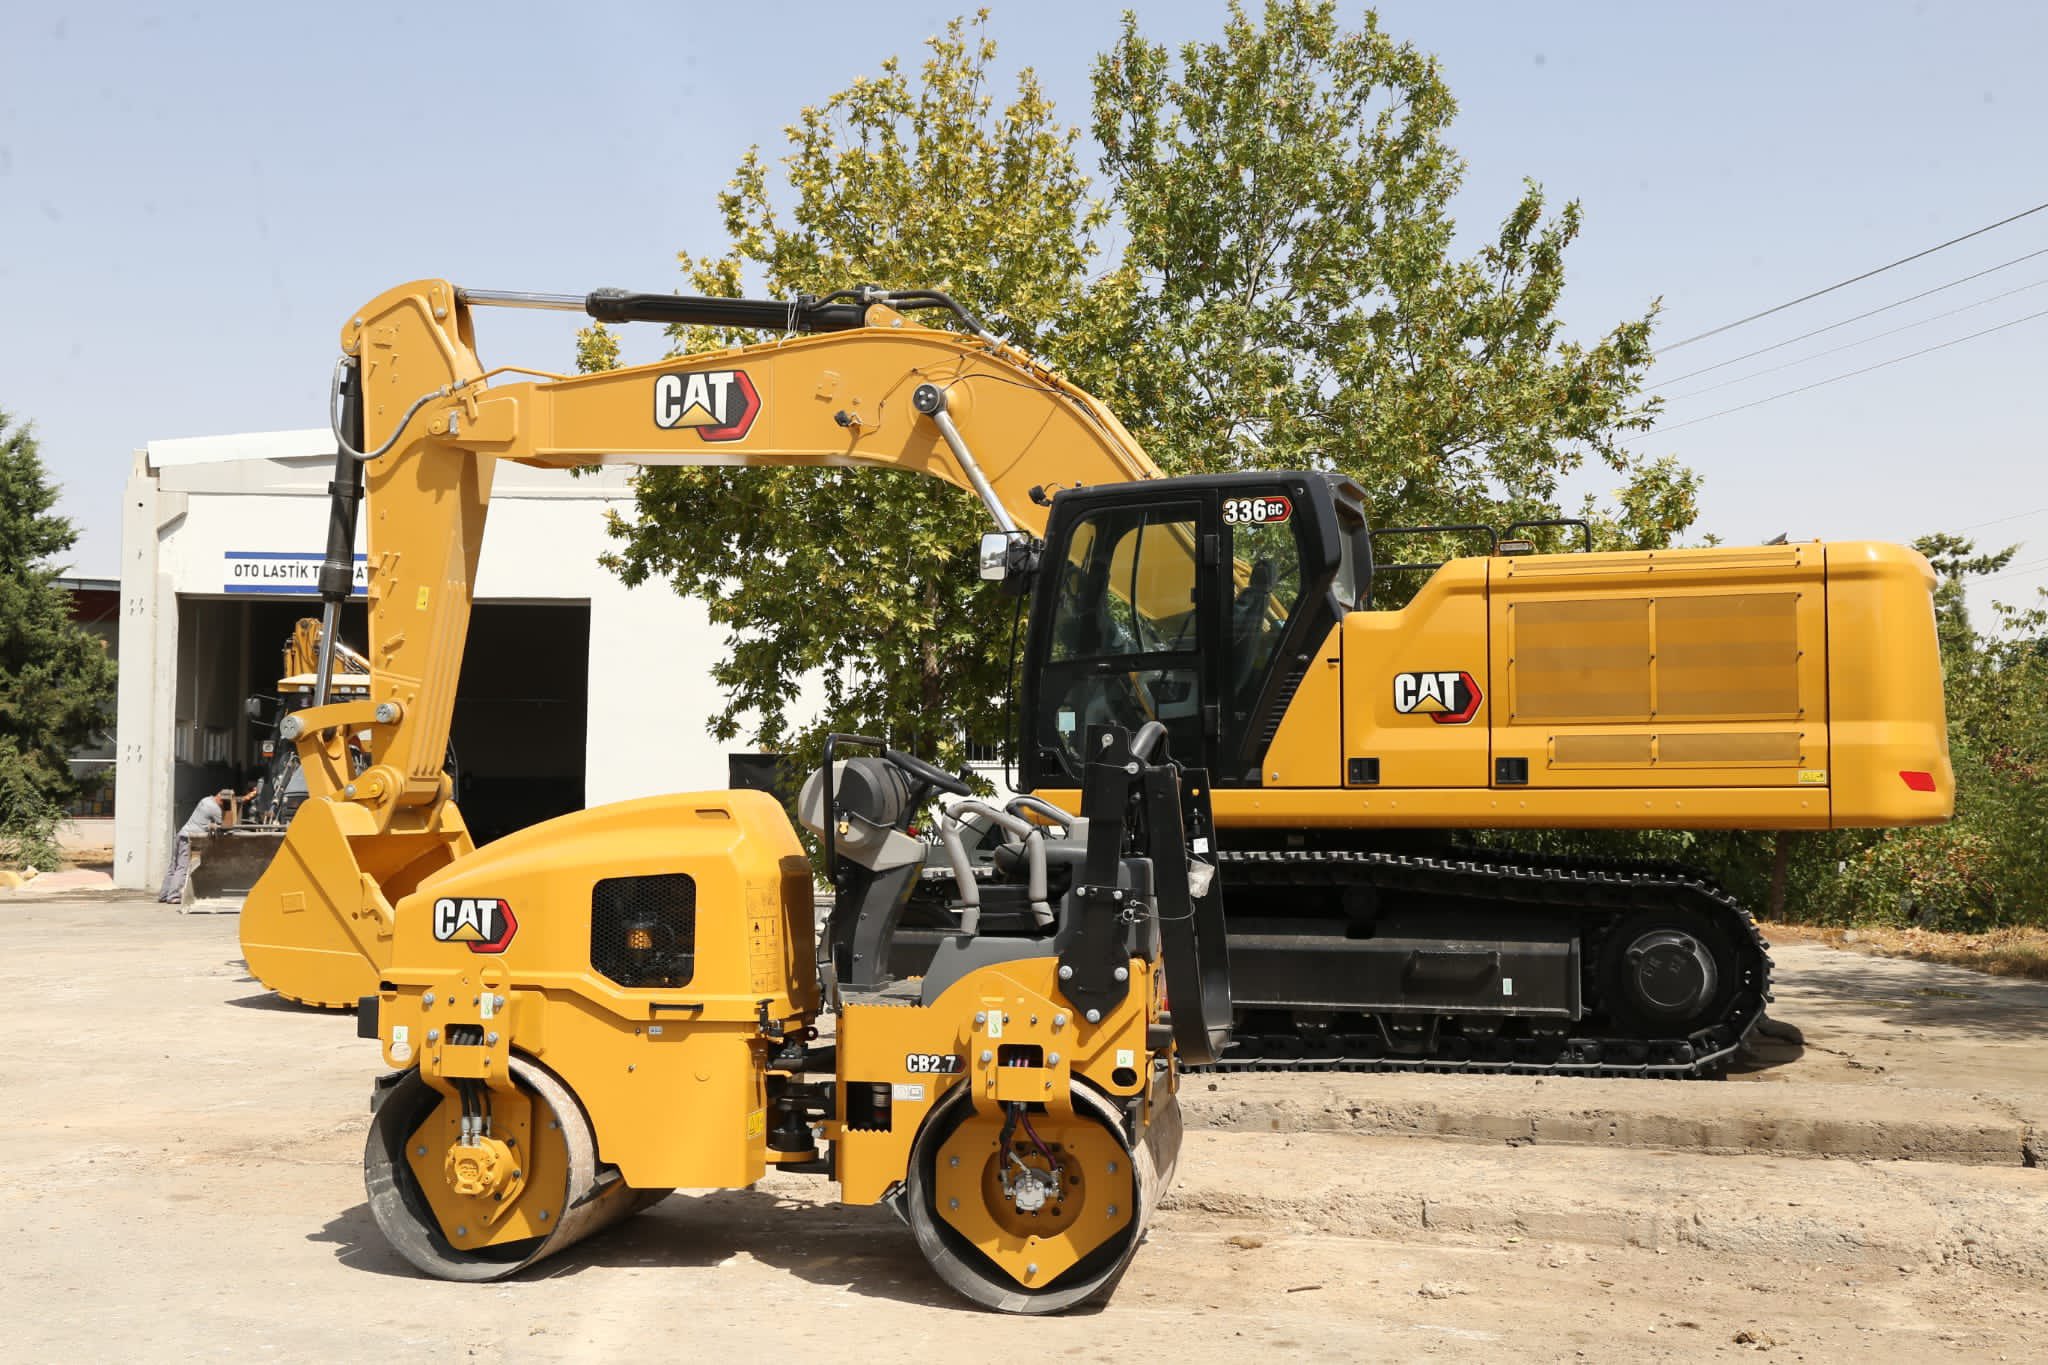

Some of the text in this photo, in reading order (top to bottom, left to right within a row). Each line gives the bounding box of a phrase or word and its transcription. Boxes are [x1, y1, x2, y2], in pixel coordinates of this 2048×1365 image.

[655, 371, 735, 428] CAT
[234, 563, 259, 578] OTO
[262, 561, 309, 579] LASTİK
[1394, 672, 1460, 713] CAT
[434, 898, 498, 941] CAT
[906, 1053, 957, 1073] CB2.7
